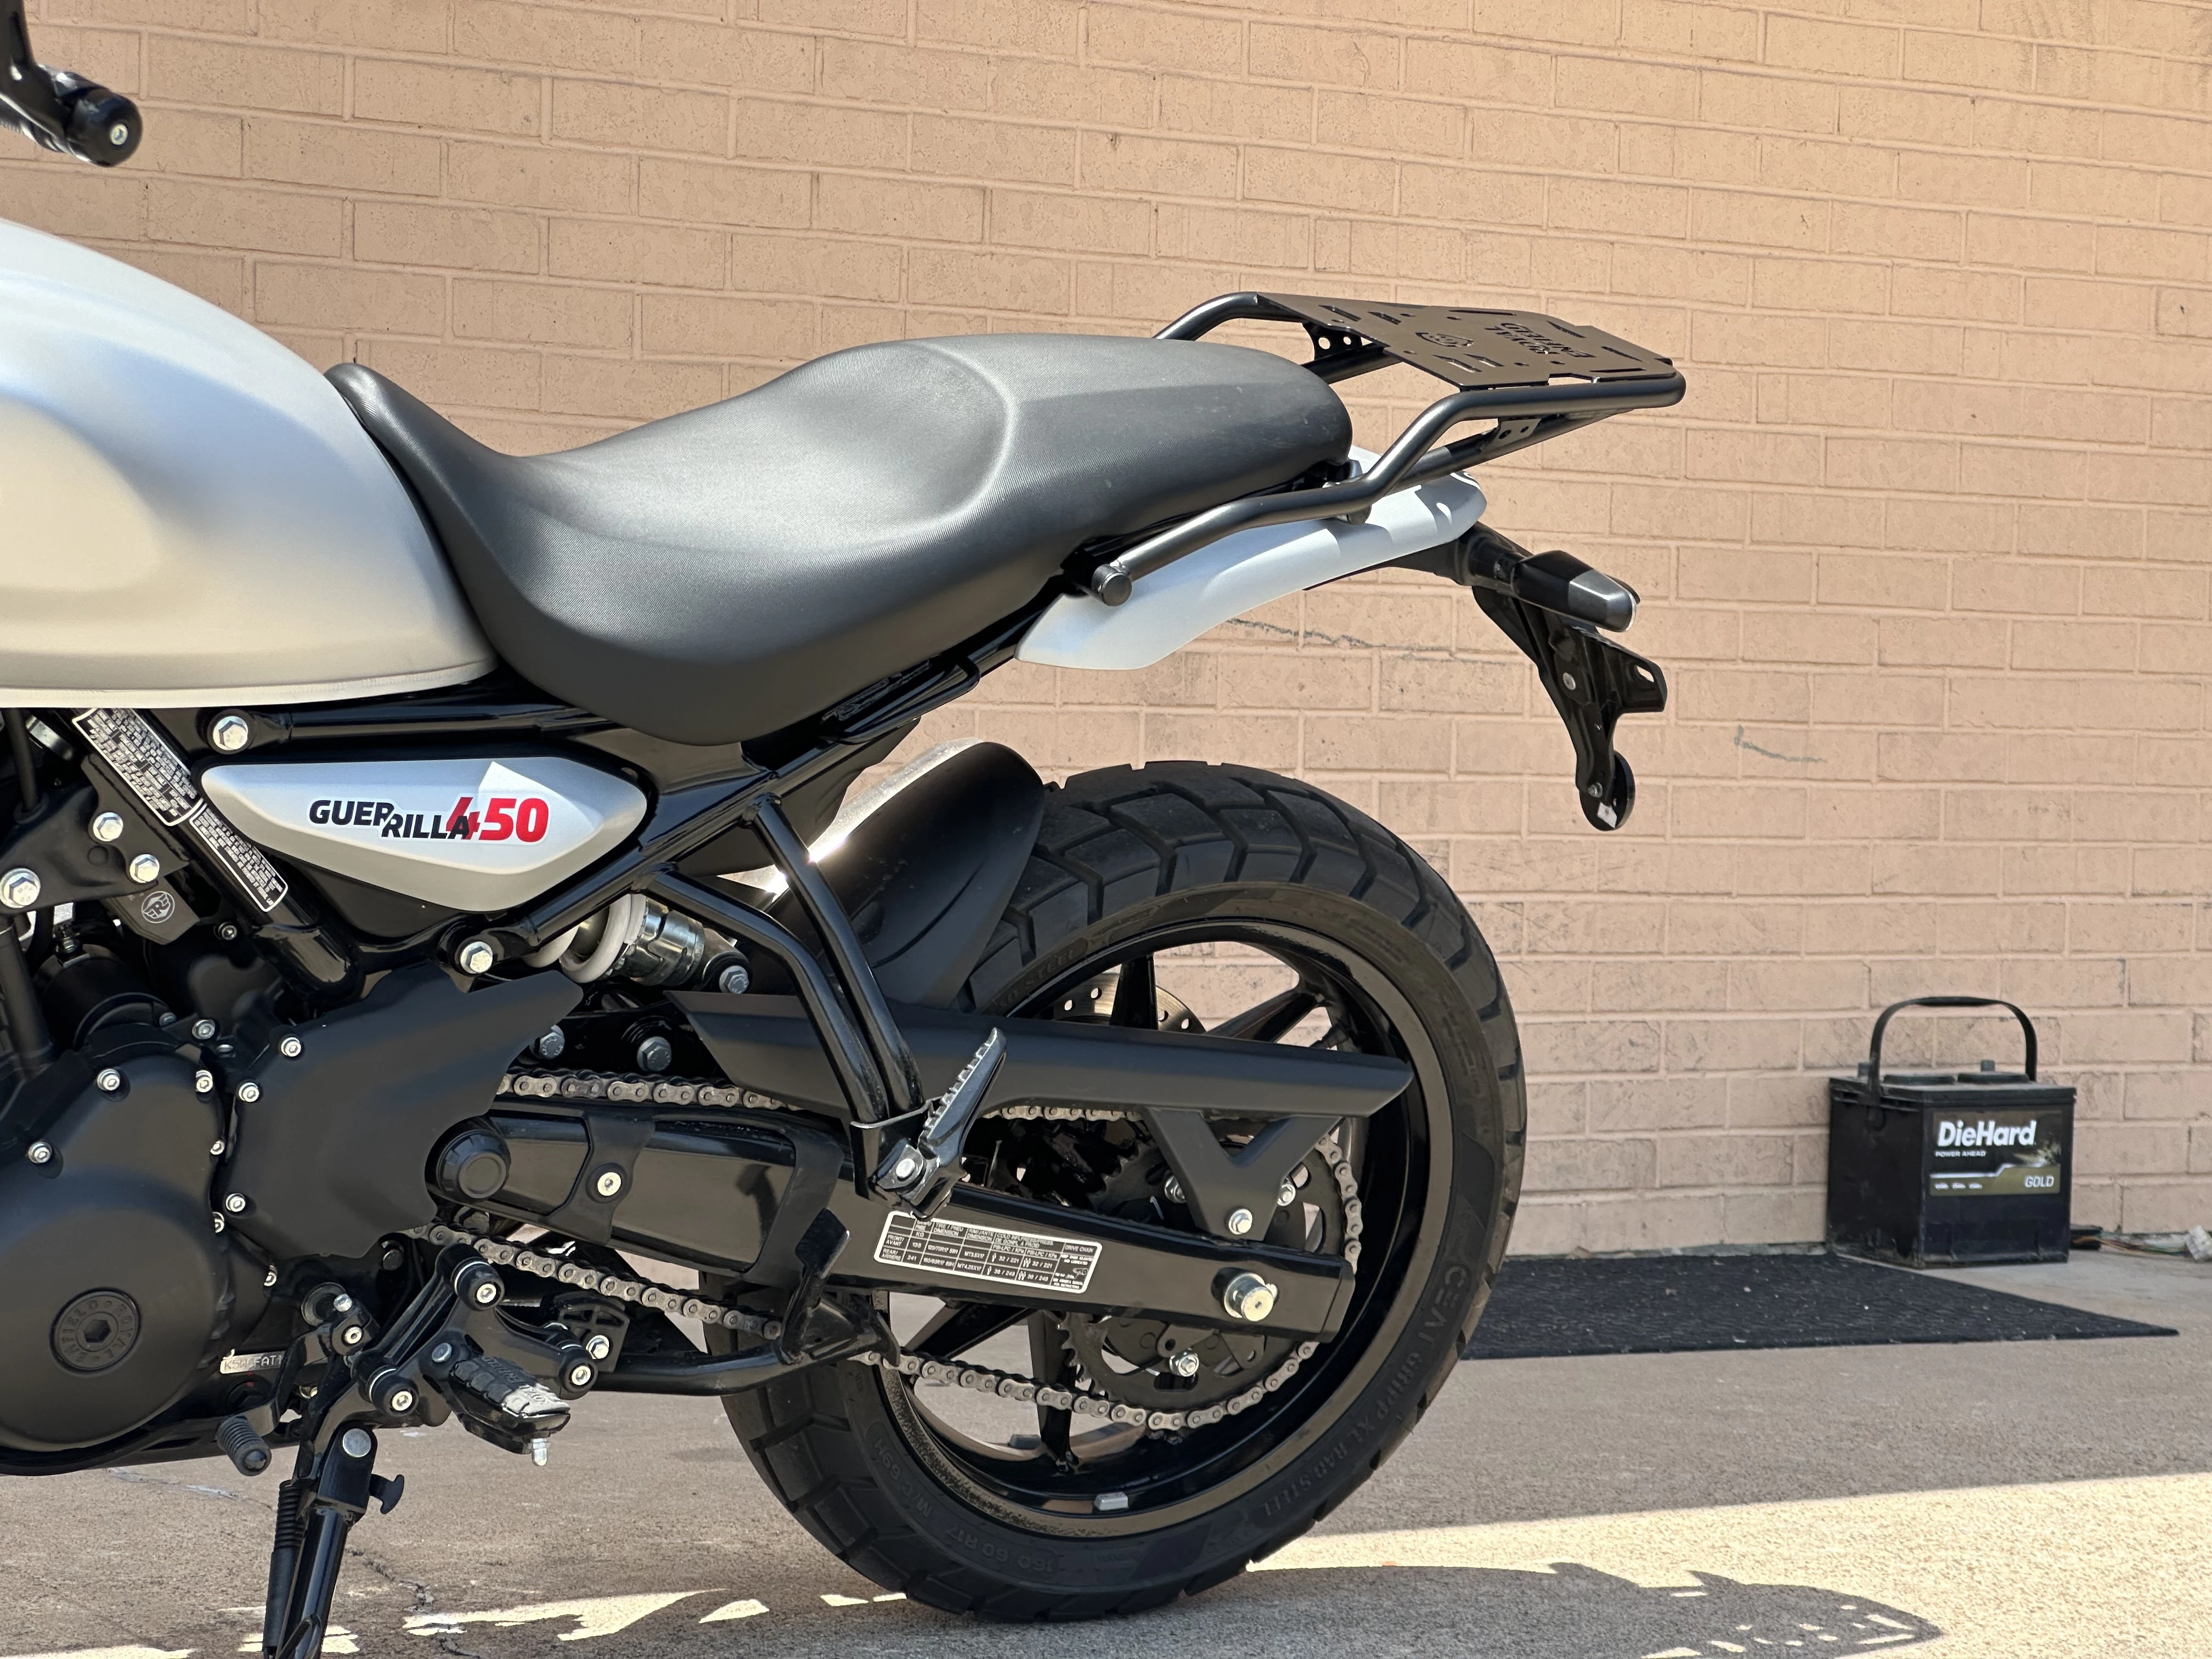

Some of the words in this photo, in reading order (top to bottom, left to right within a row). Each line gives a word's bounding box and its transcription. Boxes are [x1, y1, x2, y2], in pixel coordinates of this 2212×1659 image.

[446, 797, 549, 842] 450
[1938, 1120, 2036, 1147] DieHard
[2024, 1176, 2055, 1188] GOLD
[1419, 1265, 1467, 1346] CEAT
[1377, 1352, 1422, 1419] GRIPP
[1348, 1416, 1376, 1444] XL
[873, 1438, 901, 1480] 69H
[1260, 1476, 1313, 1516] STEEL
